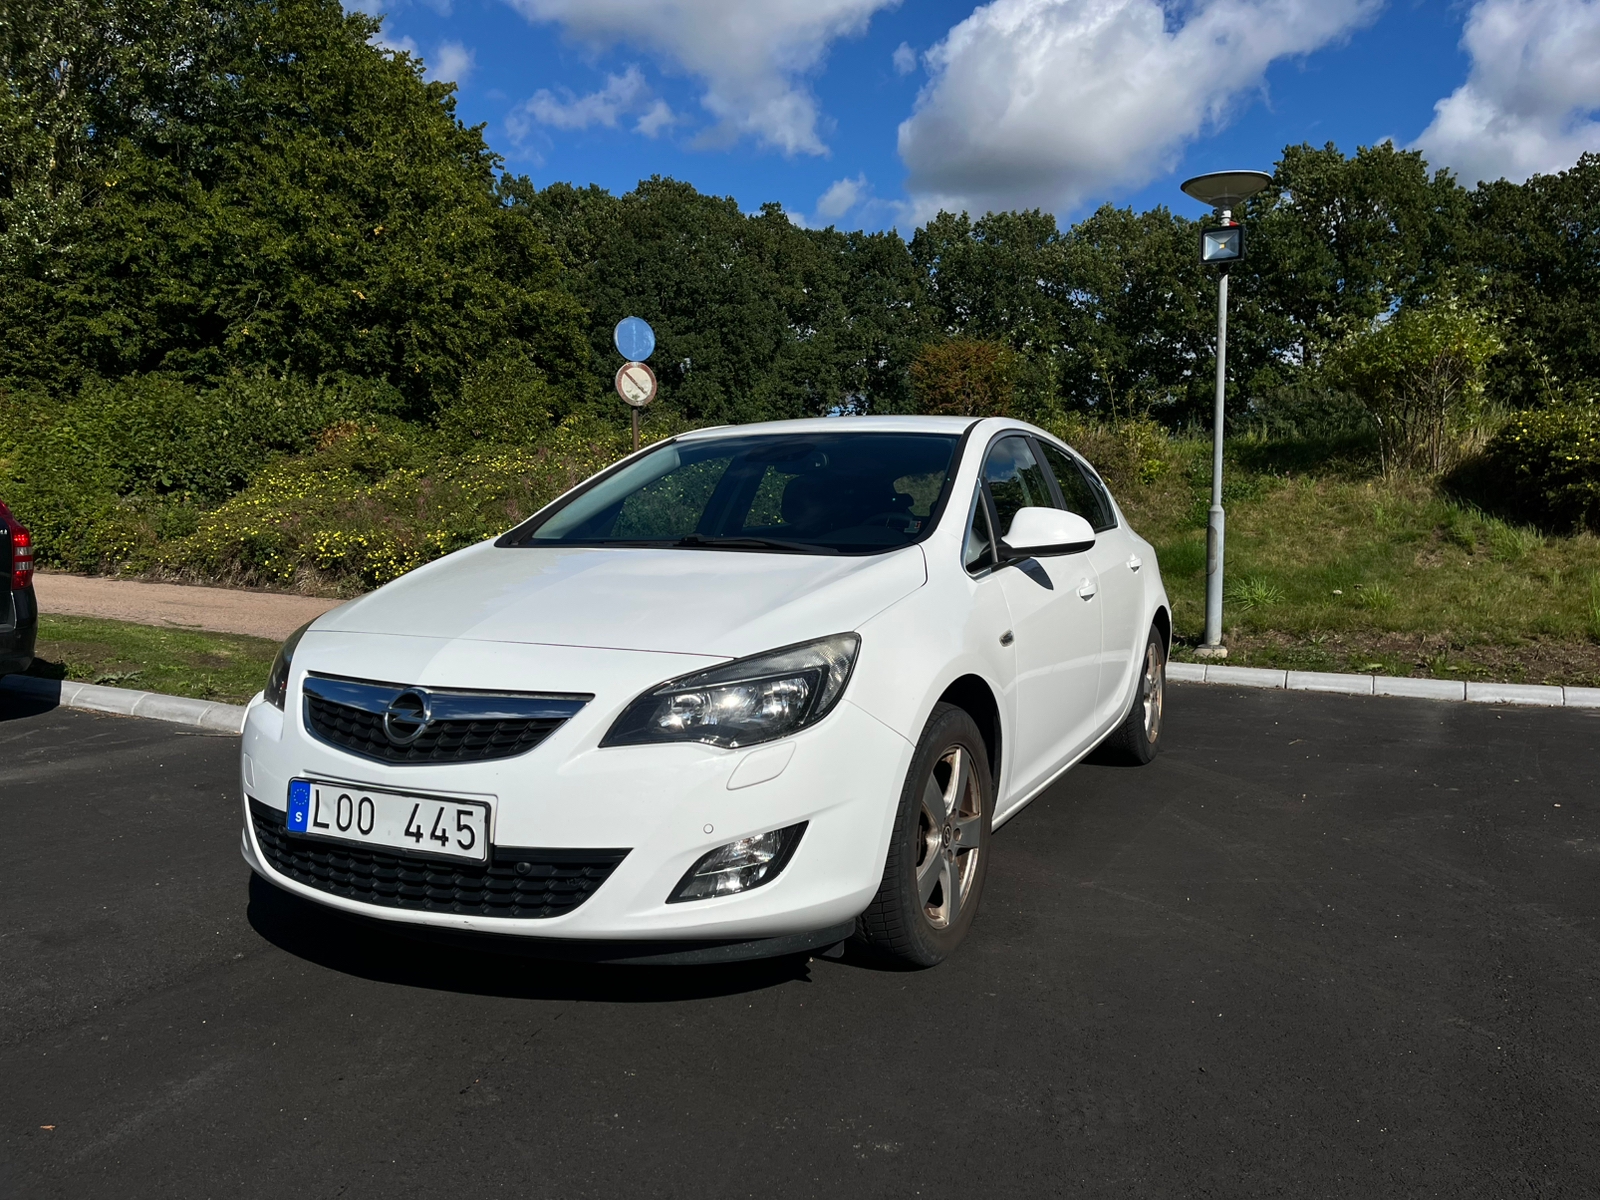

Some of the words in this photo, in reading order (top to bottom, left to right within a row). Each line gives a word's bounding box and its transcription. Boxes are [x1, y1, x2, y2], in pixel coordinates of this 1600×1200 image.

[295, 811, 303, 823] S
[313, 789, 375, 835] LOO
[404, 803, 475, 850] 445
